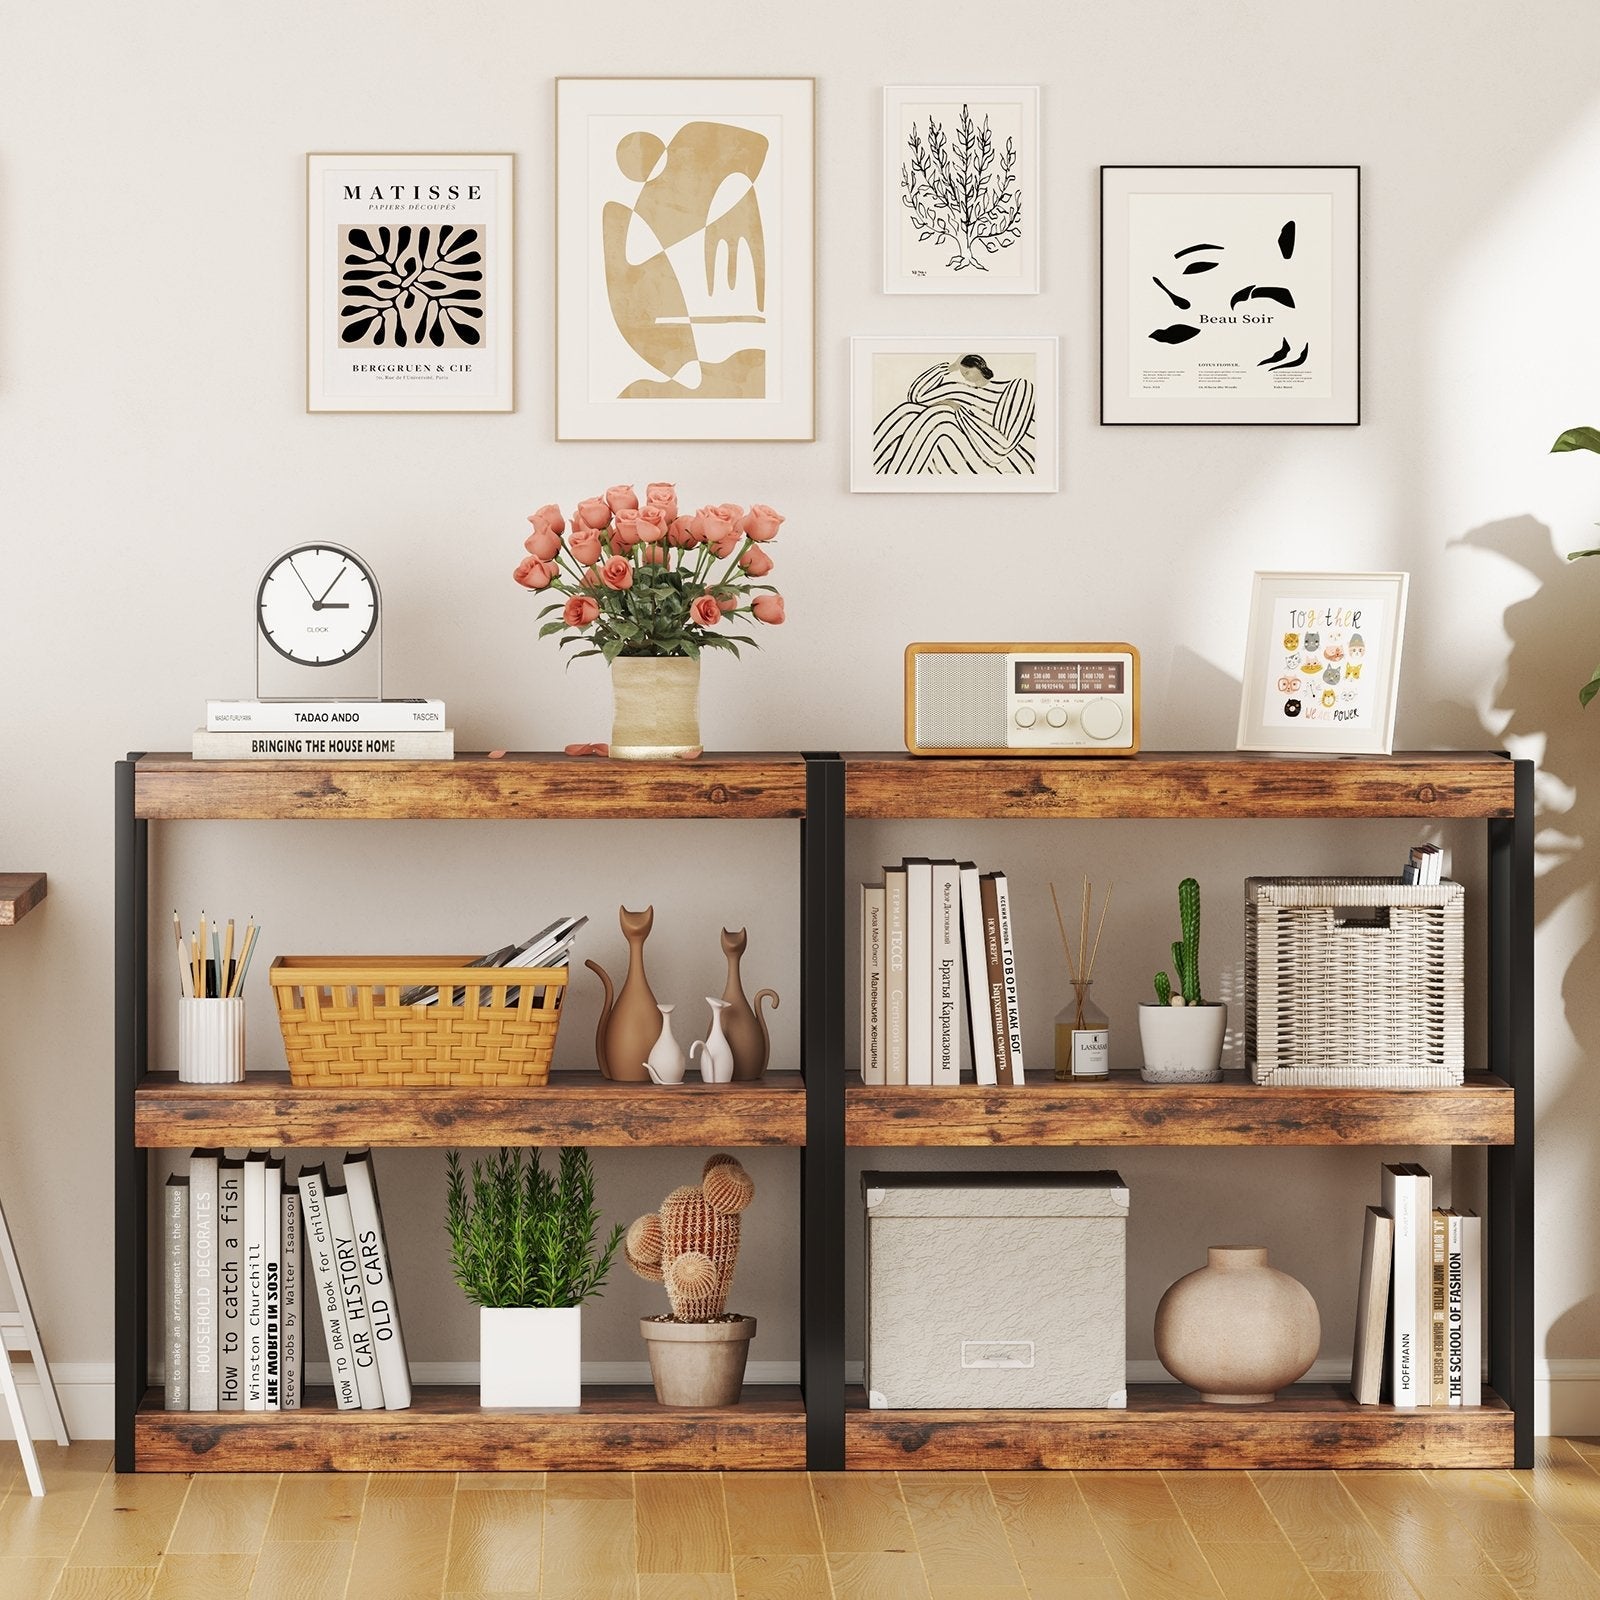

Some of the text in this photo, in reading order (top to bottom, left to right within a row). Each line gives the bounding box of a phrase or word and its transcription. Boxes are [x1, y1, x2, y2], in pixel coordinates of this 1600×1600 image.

[343, 185, 481, 200] MATISSE
[1200, 314, 1274, 324] Beau Soir
[352, 364, 473, 372] BERGGRUEN & CIE
[252, 740, 396, 752] BRINGING THE HOUSE HOME
[295, 713, 360, 722] TADAO ANDO
[871, 907, 879, 927] Луиза
[891, 930, 903, 972] ГЕССЕ
[870, 972, 879, 1069] Маленькие женщины
[939, 959, 954, 1071] Братья Карамазовы
[992, 983, 1007, 1071] Бархатная смерть
[1003, 950, 1021, 1055] ГОВОРИ КАК БОГ
[197, 1192, 210, 1373] HOUSEHOLD DECORATES
[1434, 1220, 1444, 1263] J.K. ROWLING
[1434, 1265, 1444, 1286] HARRY
[172, 1190, 182, 1403] How to make an arrangement in the house
[221, 1178, 238, 1401] How to catch a fish
[249, 1243, 260, 1401] Winston Churchill
[284, 1196, 297, 1406] Steve Jobs by Walter Isaacson
[306, 1181, 353, 1404] HOW TO DRAW Book for children
[336, 1237, 373, 1368] CAR HISTORY
[359, 1231, 393, 1341] OLD CARS
[1434, 1287, 1444, 1310] POTTER
[1449, 1253, 1462, 1399] THE SCHOOL OF FASHION
[1402, 1333, 1410, 1390] HOFFMANN
[1434, 1358, 1444, 1385] SECRETS
